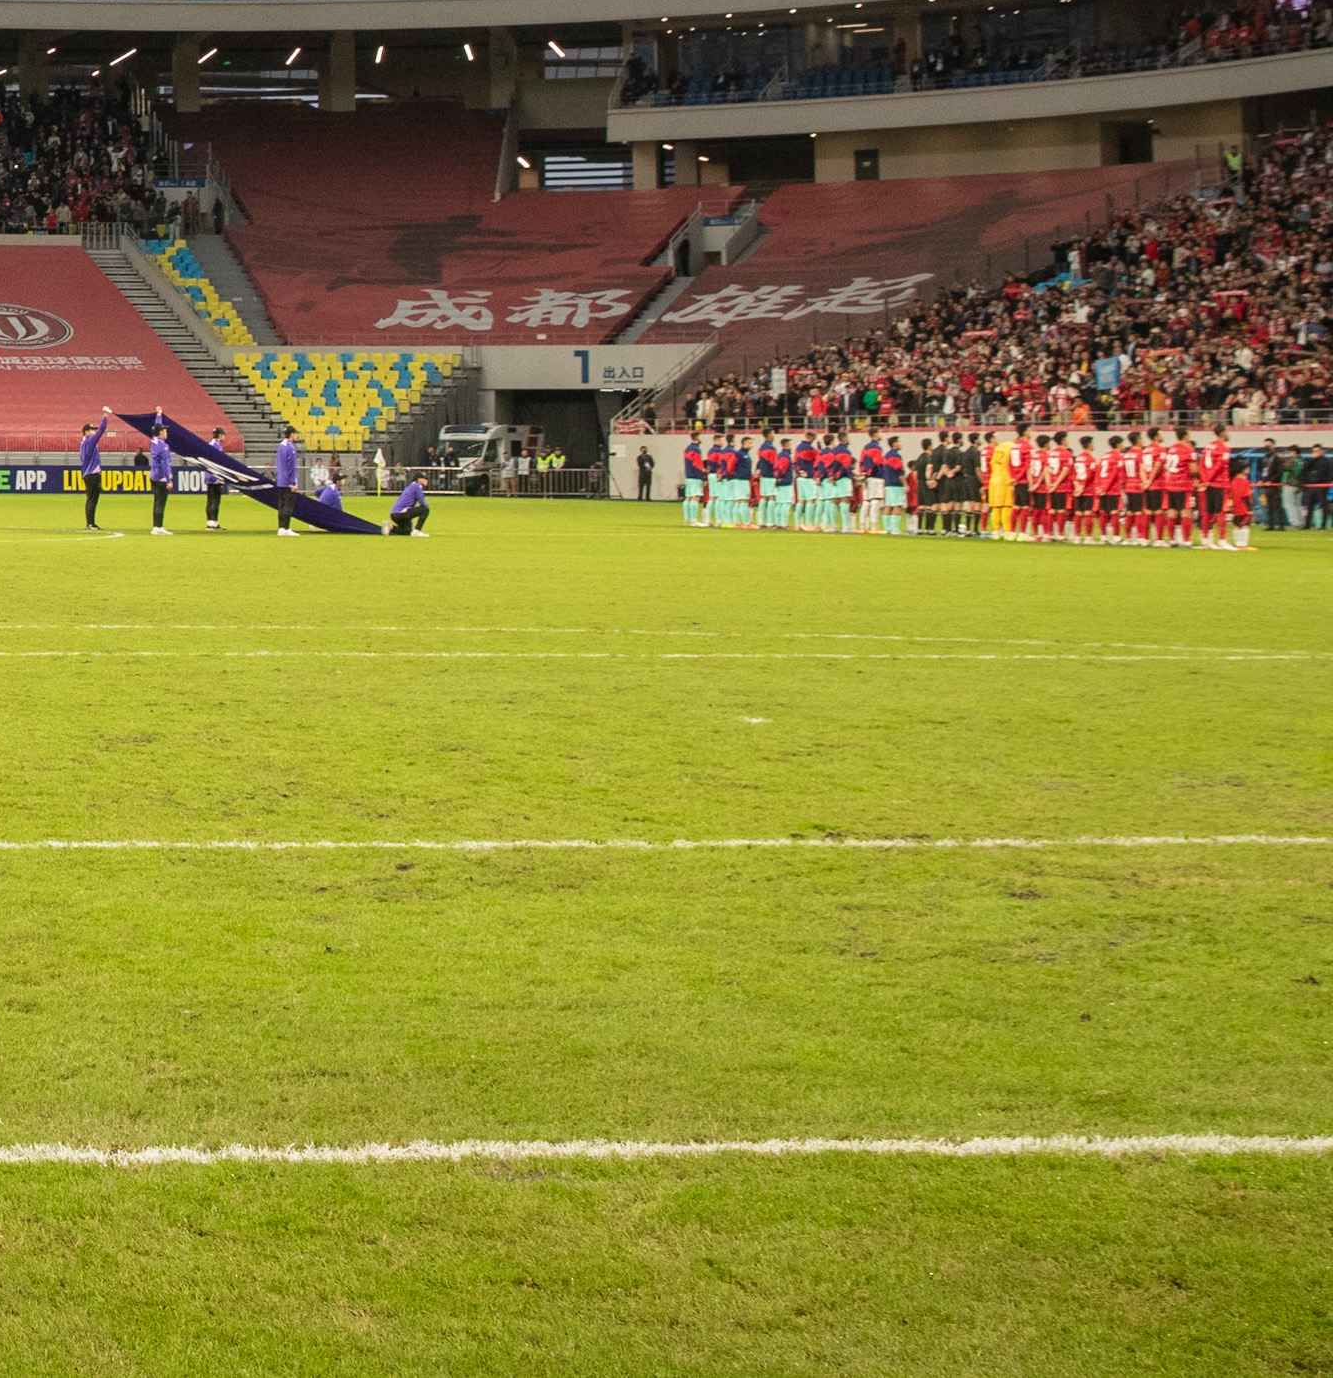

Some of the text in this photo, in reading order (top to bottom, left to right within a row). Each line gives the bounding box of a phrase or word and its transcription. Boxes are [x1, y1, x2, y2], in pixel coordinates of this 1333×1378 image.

[373, 288, 635, 331] 成都
[573, 350, 590, 384] 1
[603, 365, 645, 379] 出入口
[15, 470, 46, 490] APP
